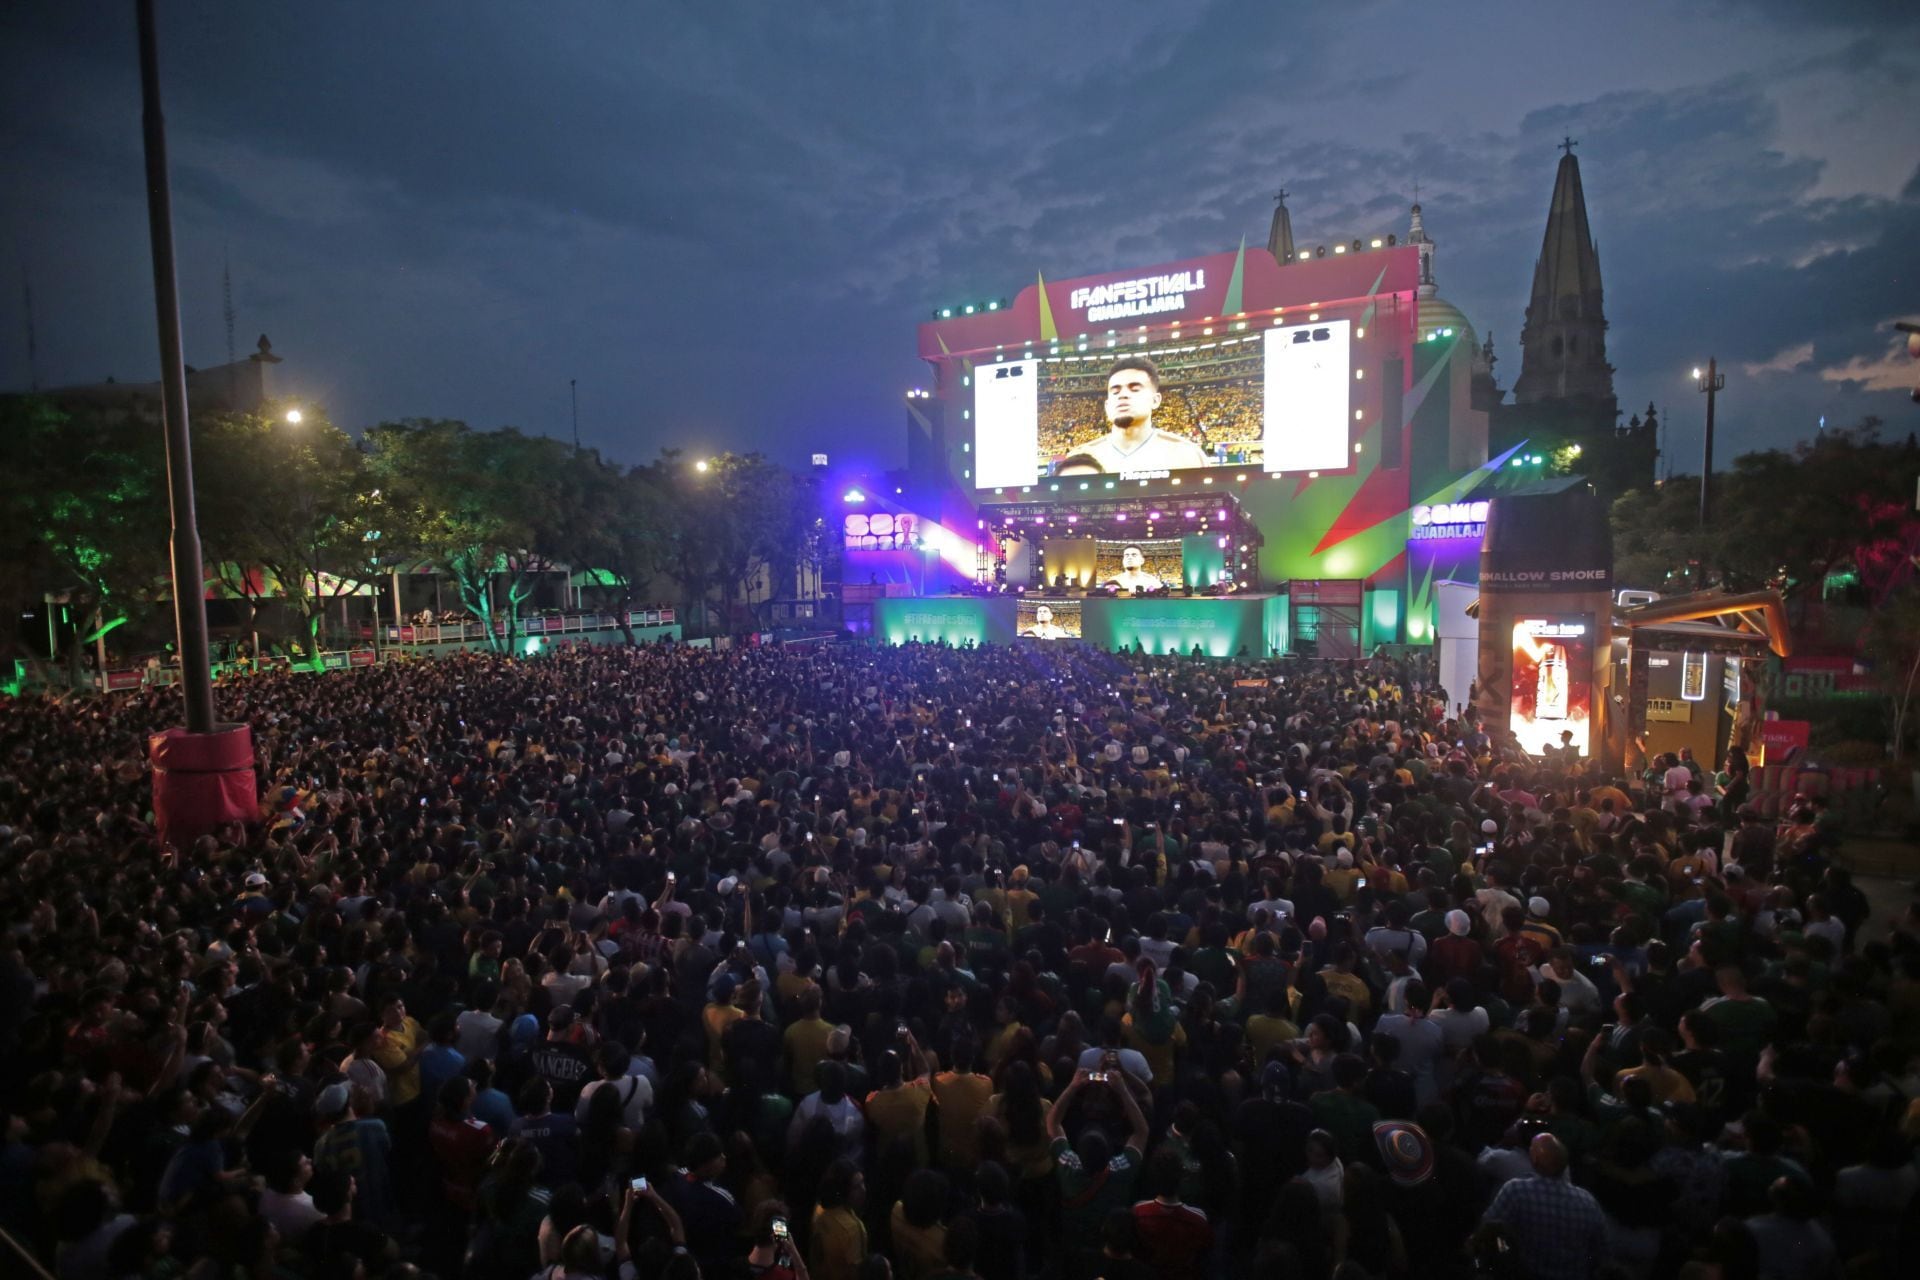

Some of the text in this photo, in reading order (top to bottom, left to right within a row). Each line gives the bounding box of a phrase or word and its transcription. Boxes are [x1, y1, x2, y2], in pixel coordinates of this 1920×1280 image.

[1292, 328, 1330, 344] 26
[995, 365, 1023, 379] 26
[1550, 570, 1606, 580] SMOKE
